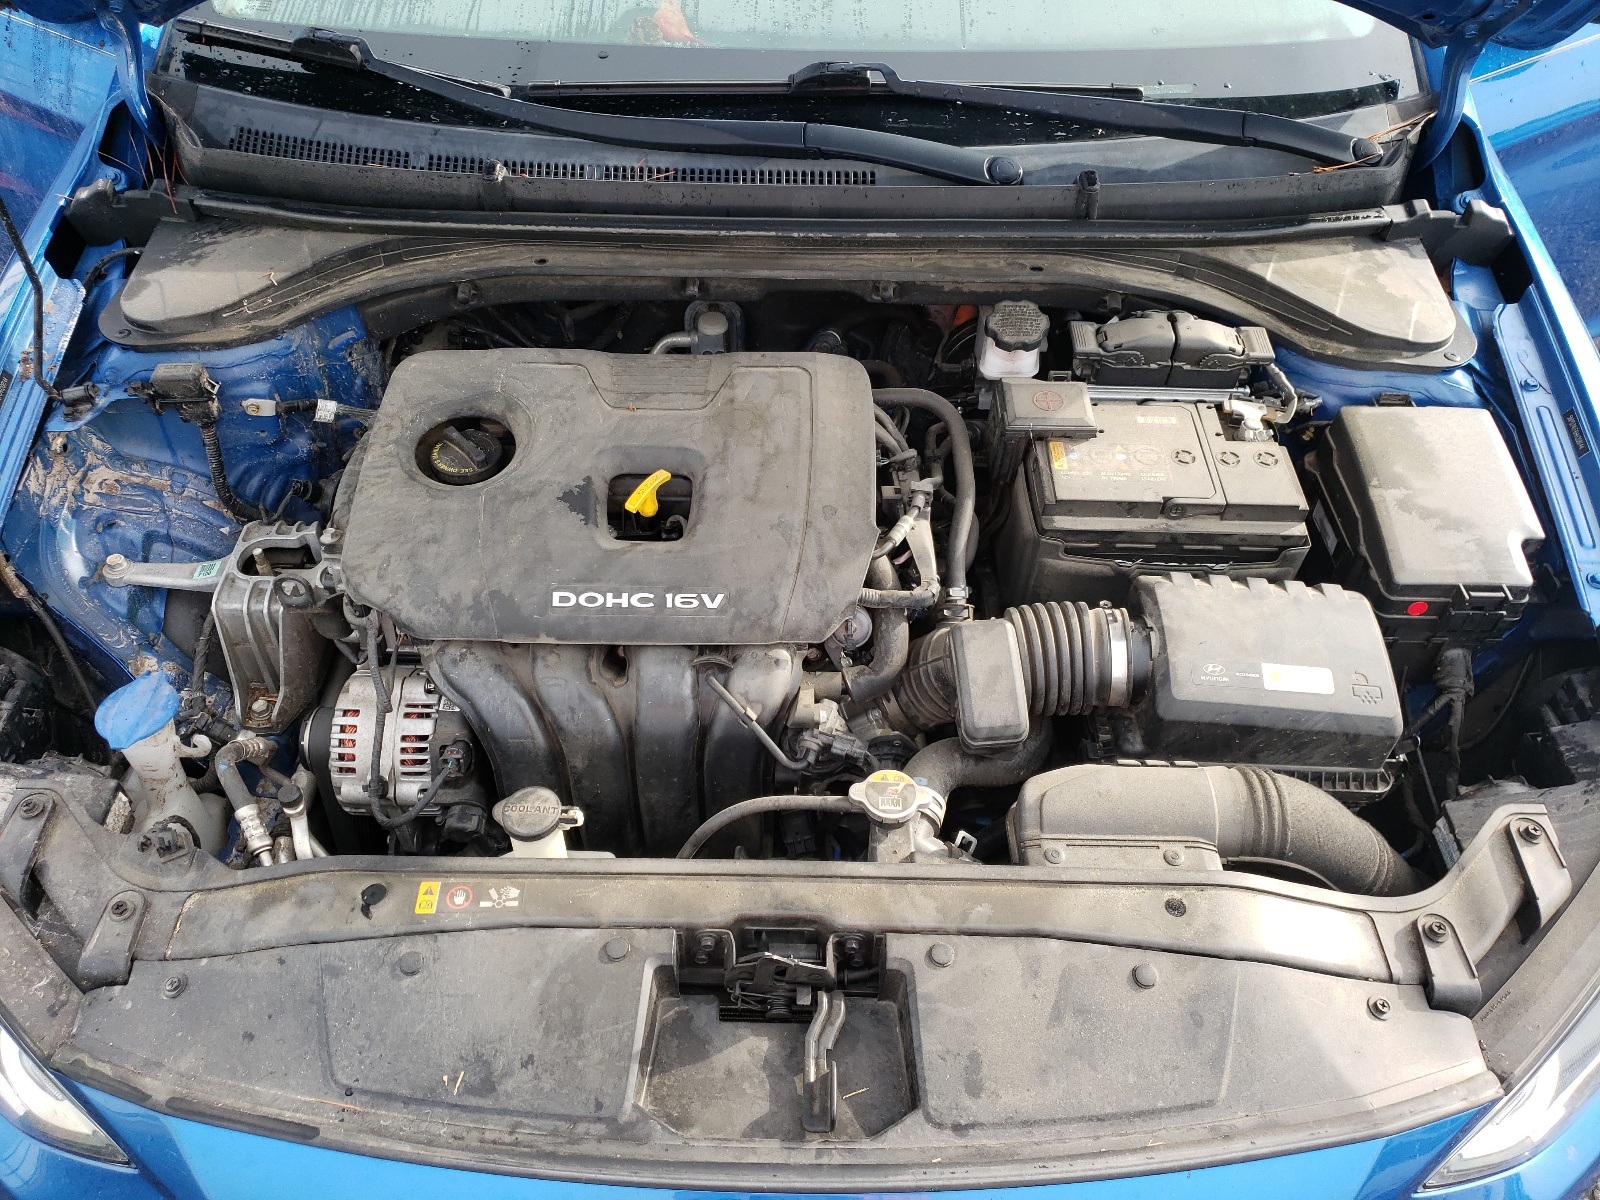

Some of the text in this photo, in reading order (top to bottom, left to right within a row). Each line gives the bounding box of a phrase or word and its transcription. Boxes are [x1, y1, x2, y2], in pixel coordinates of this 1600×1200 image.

[552, 591, 726, 609] DOHC 16V
[1200, 675, 1230, 683] HYUNDAI
[502, 804, 559, 815] COOLANT
